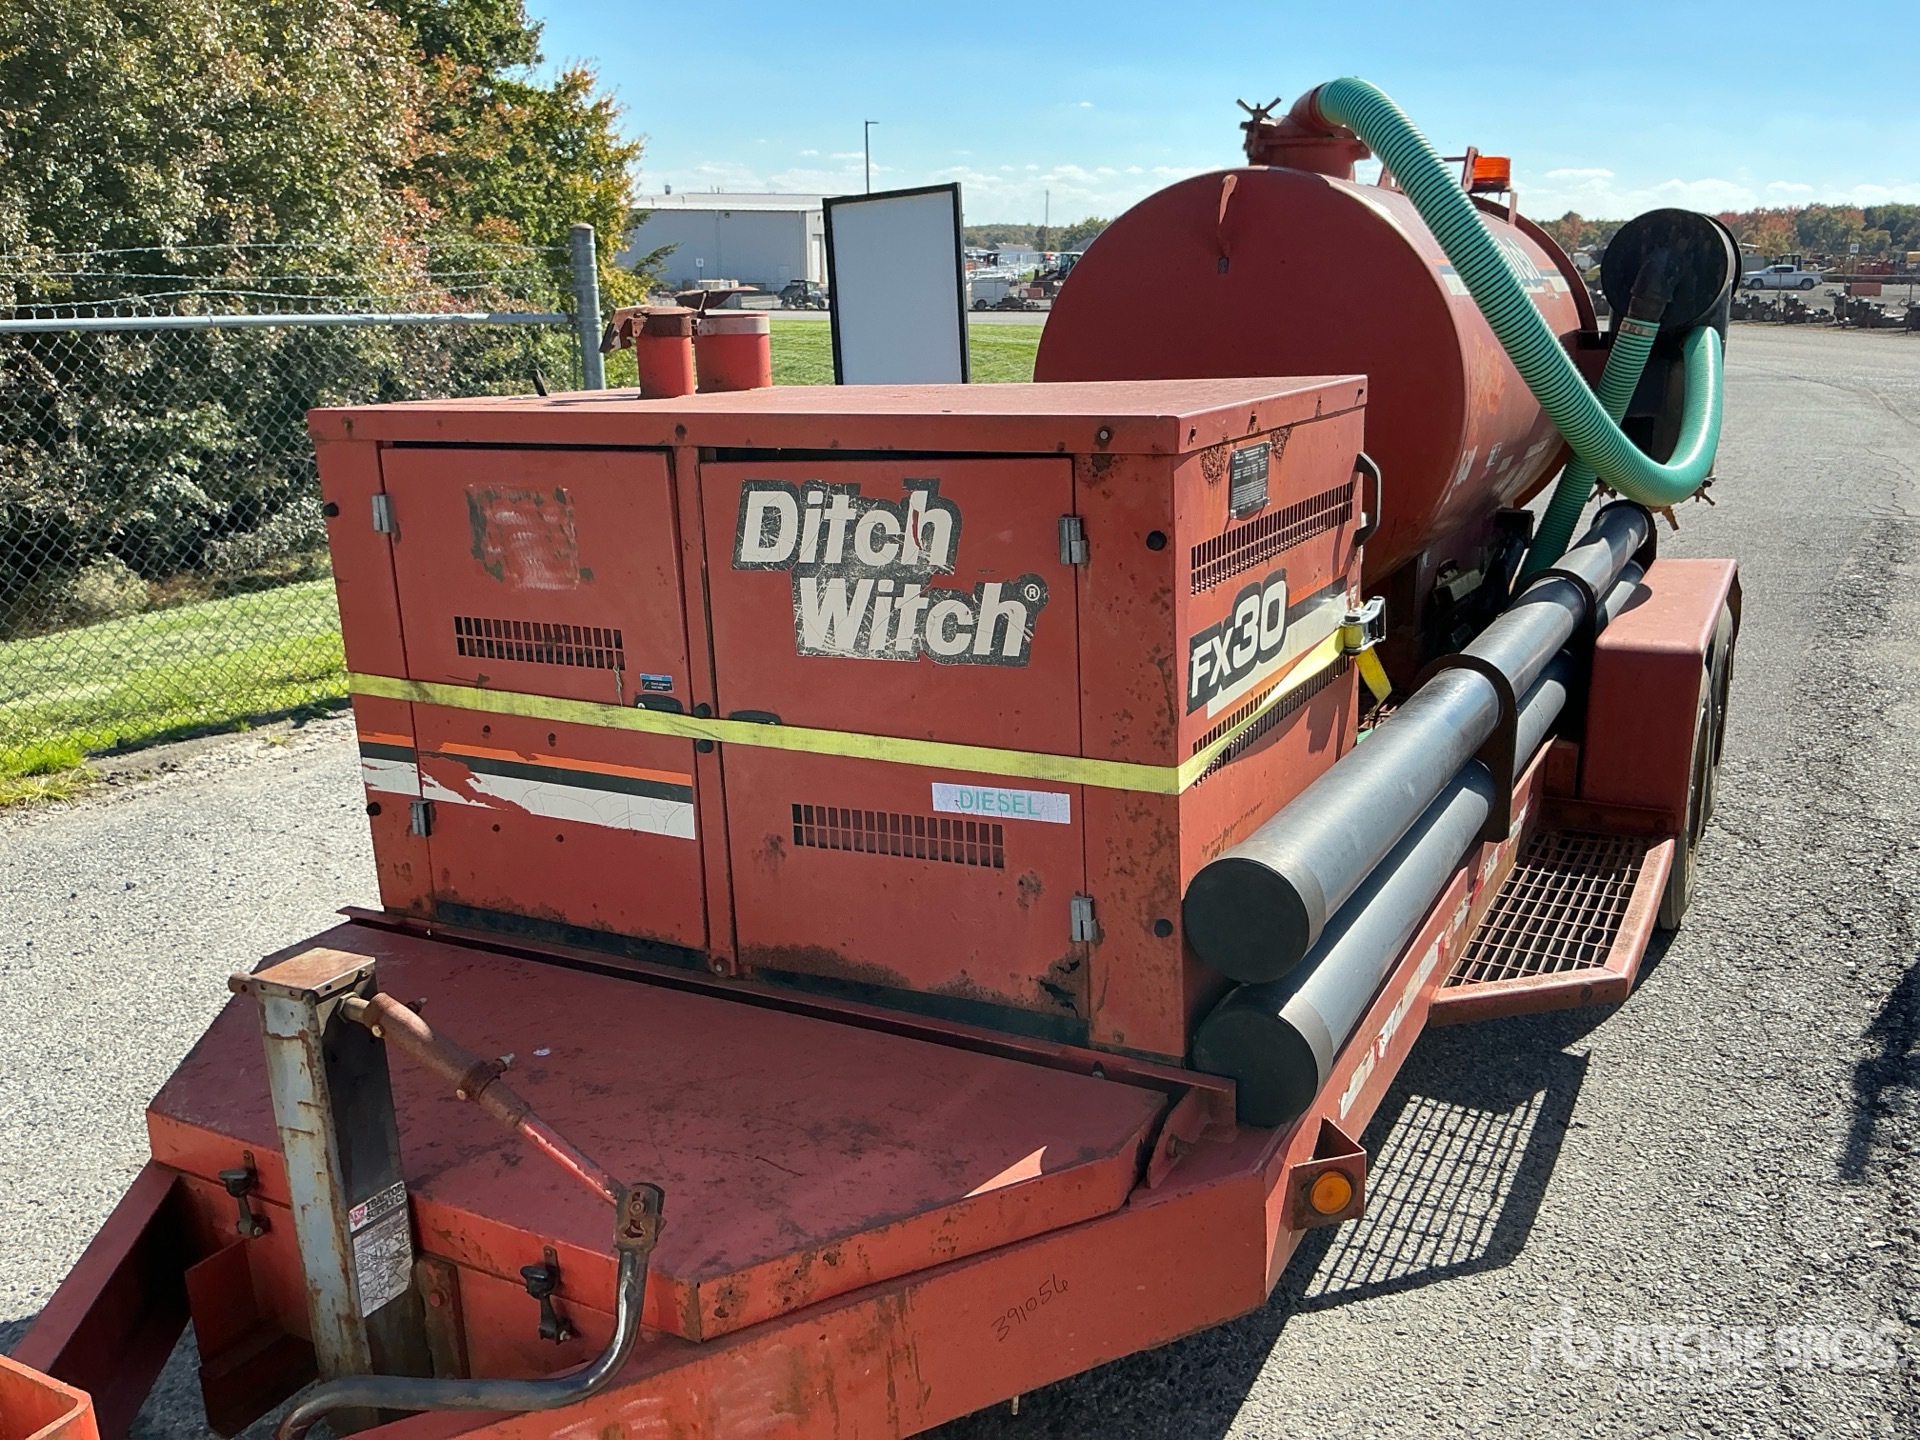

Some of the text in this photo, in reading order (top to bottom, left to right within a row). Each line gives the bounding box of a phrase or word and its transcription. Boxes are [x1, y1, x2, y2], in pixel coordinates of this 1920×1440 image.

[740, 489, 953, 567] Ditch
[1190, 579, 1287, 700] FX30
[959, 789, 1041, 816] DIESEL
[366, 1183, 405, 1211] TRACTOR
[366, 1197, 395, 1221] SUPPLY
[990, 1273, 1070, 1343] 391056
